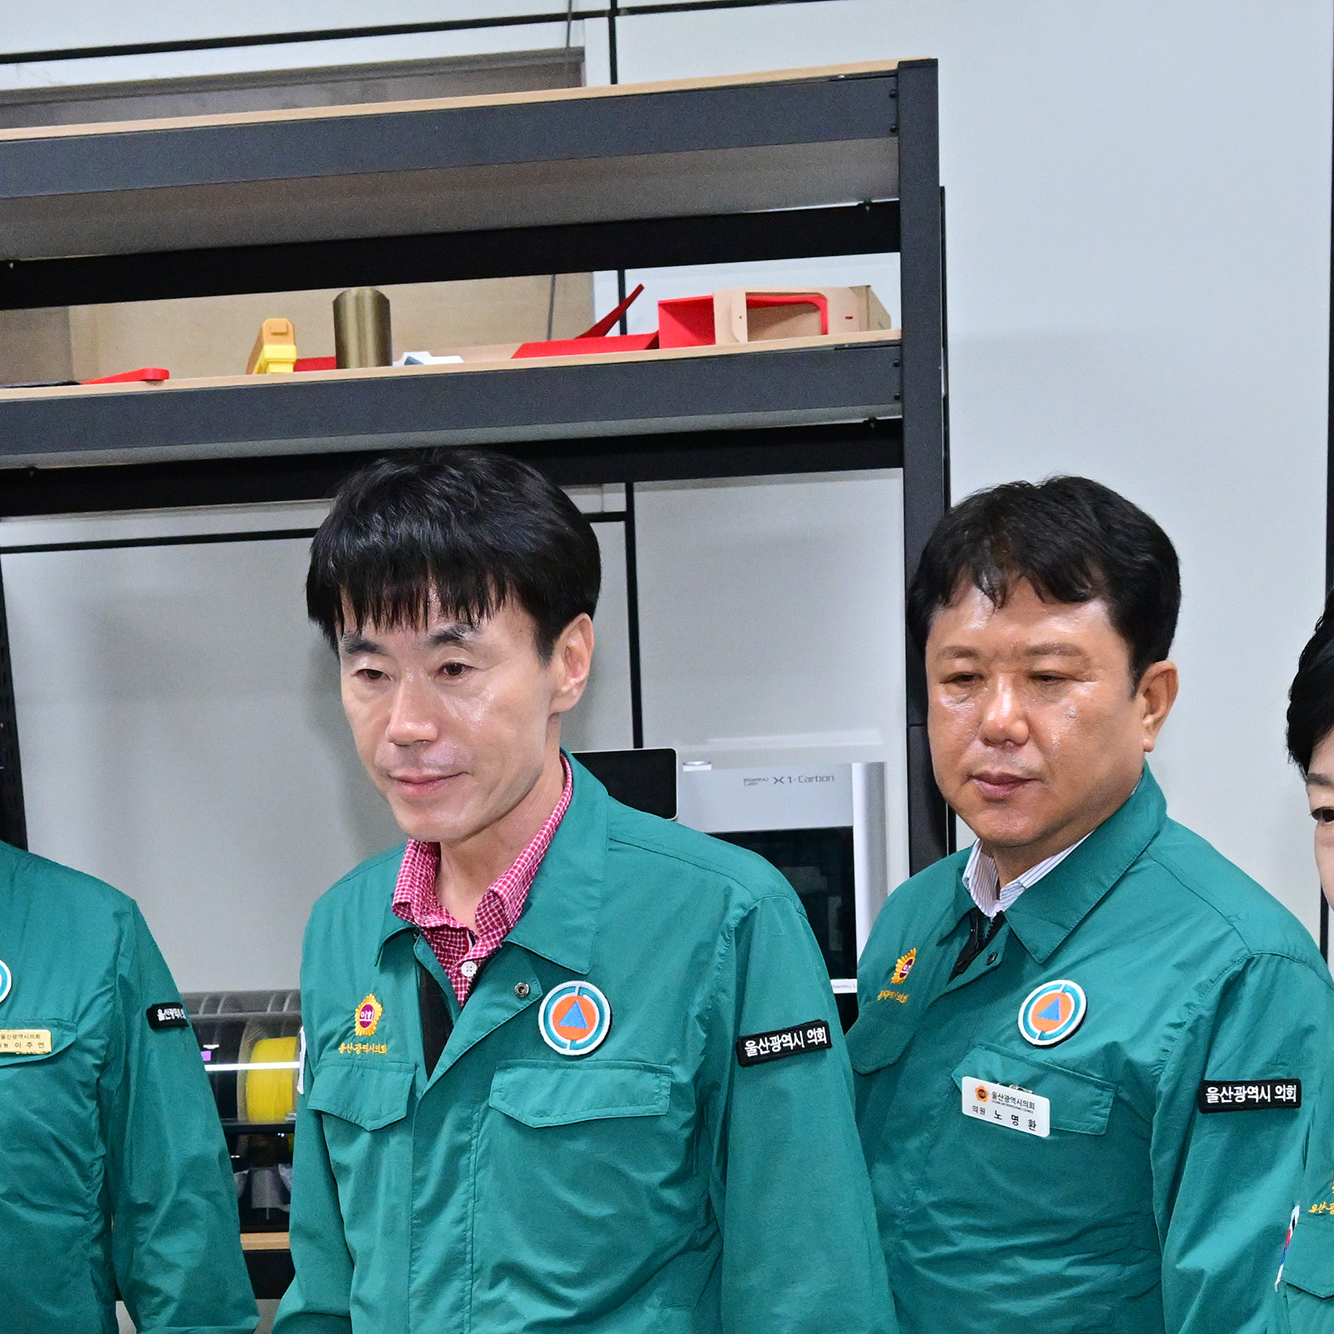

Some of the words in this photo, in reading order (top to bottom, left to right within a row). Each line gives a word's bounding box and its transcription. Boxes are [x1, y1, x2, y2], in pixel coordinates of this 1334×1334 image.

[744, 1030, 805, 1057] 울산광역시
[807, 1026, 827, 1045] 의회
[991, 1091, 1035, 1110] 울산광역시의회
[1205, 1084, 1271, 1104] 울산광역시
[1274, 1084, 1297, 1102] 의회
[972, 1105, 985, 1115] 의원
